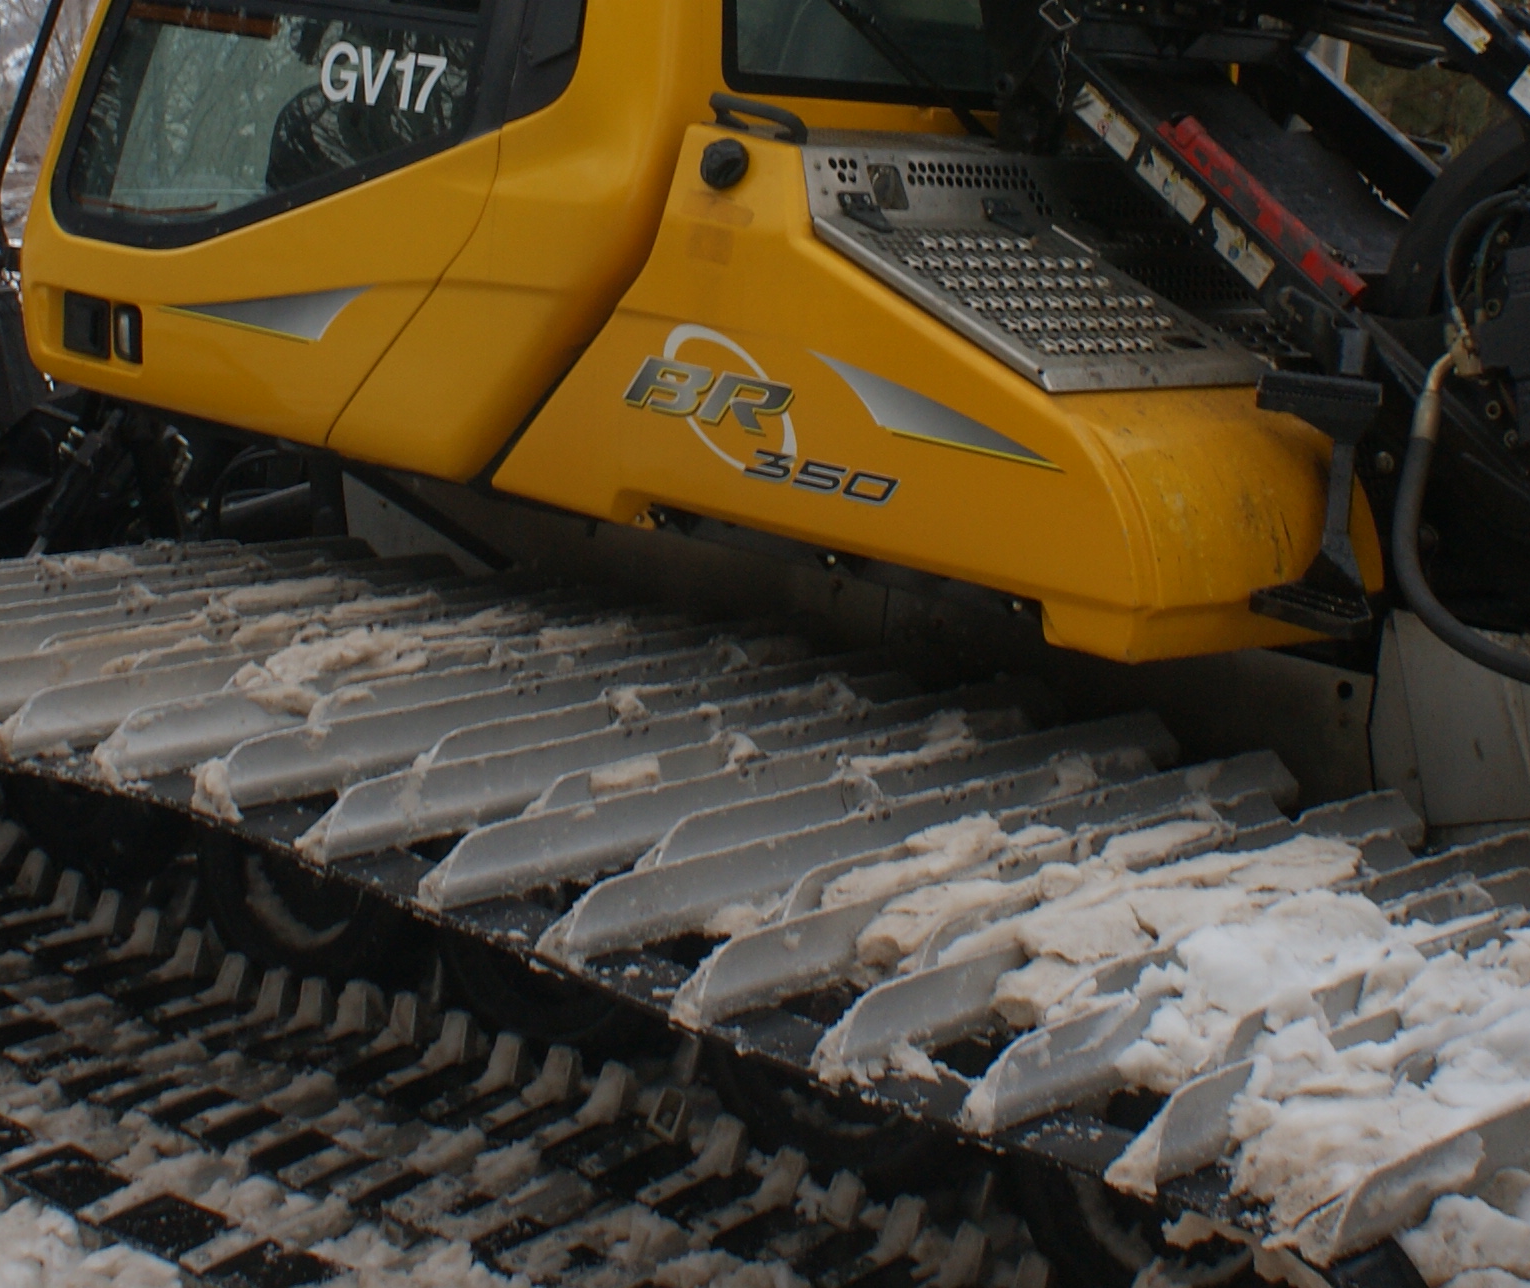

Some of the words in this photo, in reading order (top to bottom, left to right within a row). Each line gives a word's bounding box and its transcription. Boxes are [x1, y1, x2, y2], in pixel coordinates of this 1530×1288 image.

[321, 41, 448, 114] GV17
[622, 355, 795, 436] BR
[742, 448, 901, 506] 350
